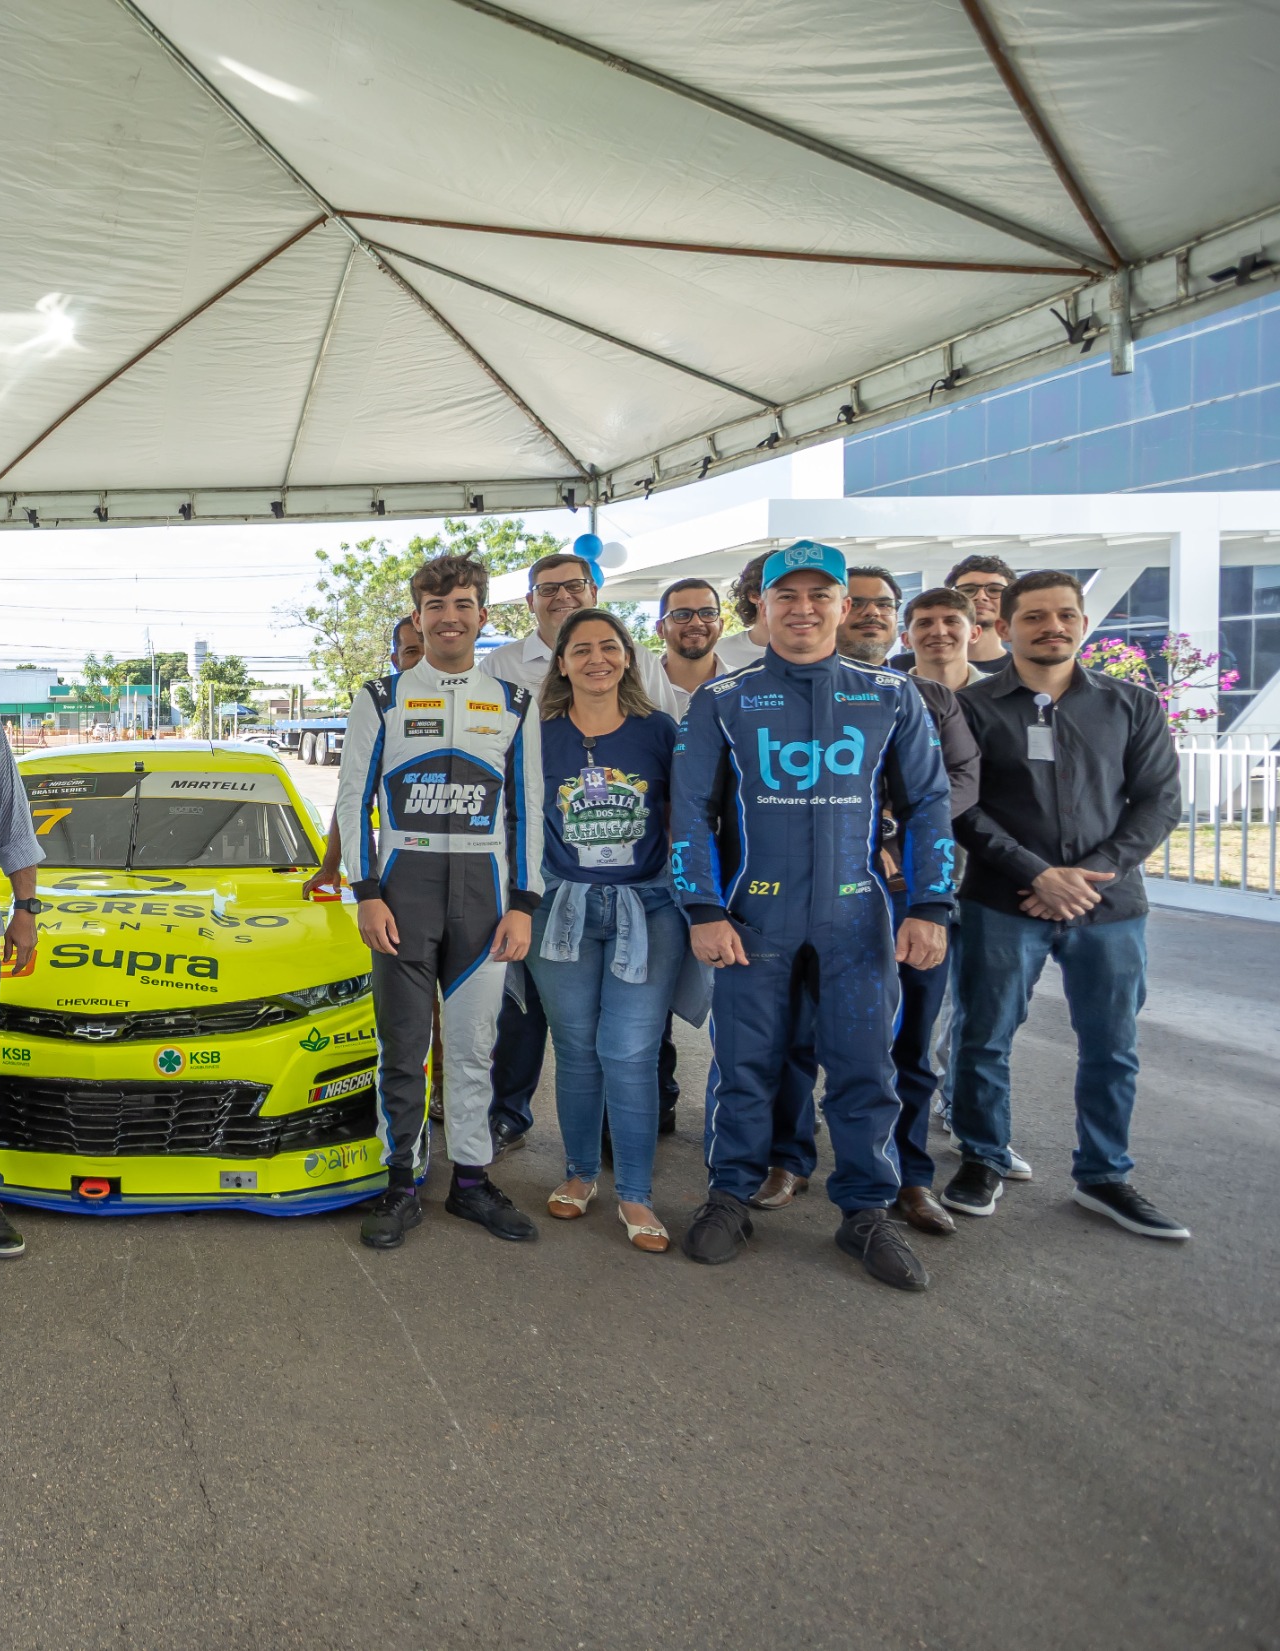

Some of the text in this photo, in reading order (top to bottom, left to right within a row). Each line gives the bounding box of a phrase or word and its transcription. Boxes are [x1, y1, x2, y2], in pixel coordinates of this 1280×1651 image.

[441, 677, 469, 686] HRX
[757, 725, 865, 791] tgd
[170, 780, 256, 791] MARTELLI
[757, 795, 862, 805] Software de Gestão
[596, 810, 614, 818] DOS
[564, 819, 646, 842] AMIGOS
[748, 881, 781, 896] 521
[37, 920, 253, 944] MENTES
[49, 944, 219, 979] Supra
[140, 975, 219, 993] Sementes
[56, 998, 131, 1008] CHEVROLET
[2, 1047, 31, 1061] KSB
[190, 1051, 221, 1064] KSB
[325, 1070, 373, 1099] NASCAR
